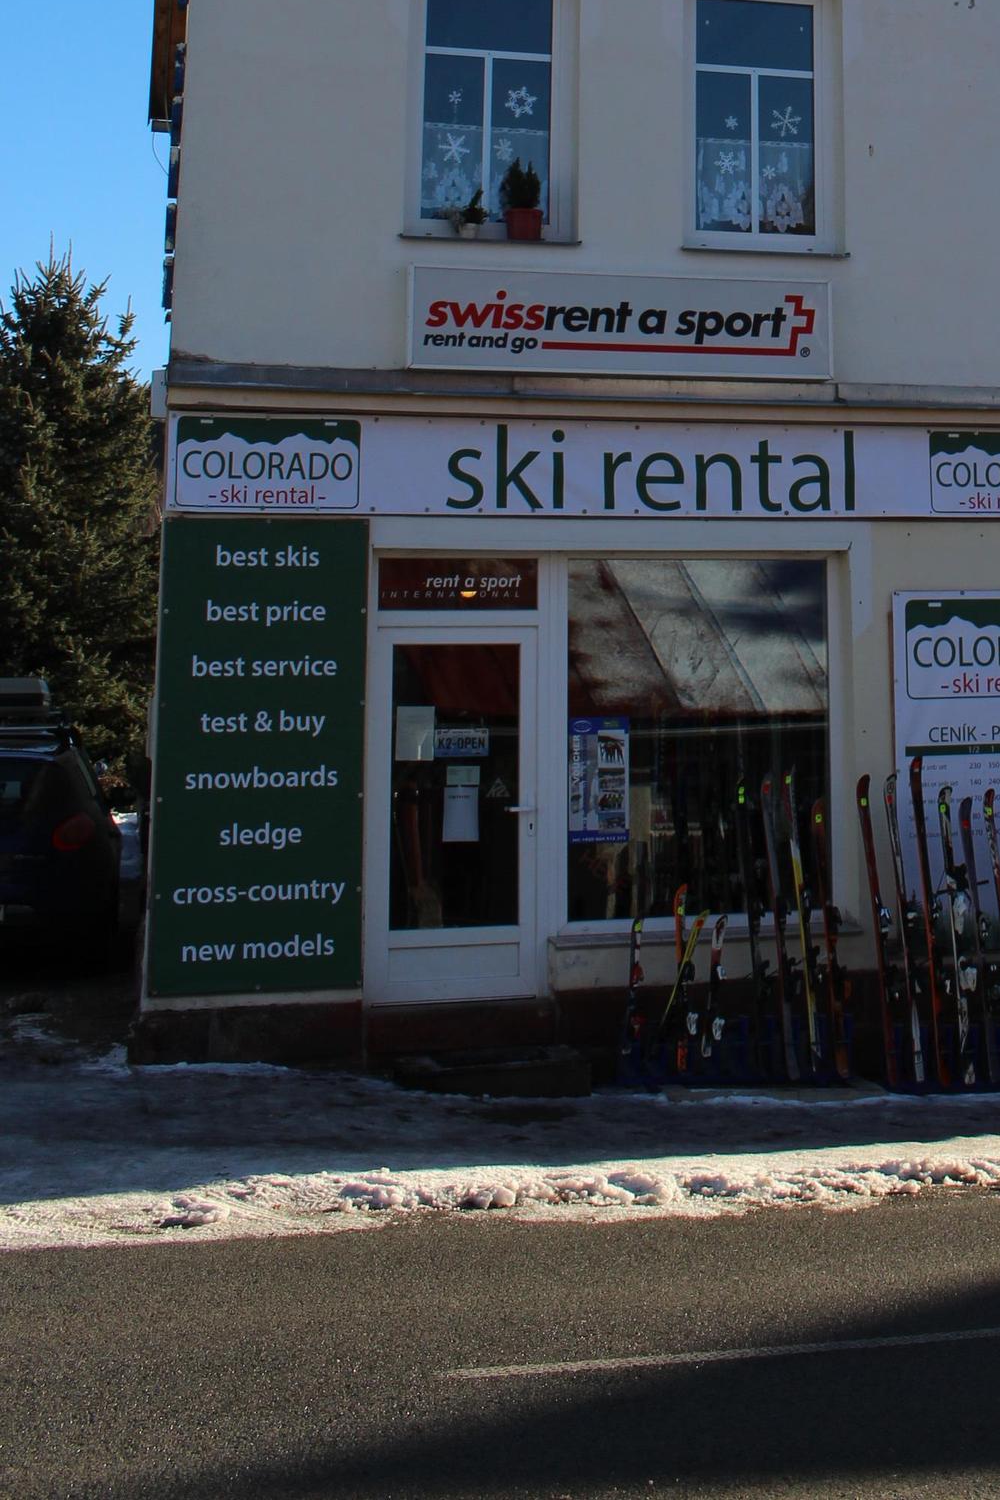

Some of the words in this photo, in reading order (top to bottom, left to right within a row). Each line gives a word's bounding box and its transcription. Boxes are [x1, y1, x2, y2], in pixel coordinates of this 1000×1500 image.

[638, 309, 669, 334] a
[676, 306, 787, 345] sport
[423, 332, 466, 348] rent
[467, 333, 508, 348] and
[511, 337, 538, 354] go
[182, 450, 353, 481] COLORADO
[446, 423, 566, 510] ski
[602, 430, 857, 512] rental
[216, 544, 268, 567] best
[275, 545, 320, 567] skis
[381, 590, 521, 599] INTERNAONAL
[425, 574, 460, 588] rent
[464, 577, 475, 588] a
[480, 573, 522, 592] sport
[206, 599, 259, 621] best
[266, 600, 326, 627] price
[192, 655, 245, 677] best
[252, 655, 338, 677] service
[200, 712, 248, 733] test
[254, 710, 273, 732] &
[279, 709, 326, 737] buy
[928, 723, 977, 743] CENÍK
[437, 737, 485, 750] K2-OPEN
[572, 733, 581, 785] VOUCHER
[185, 764, 338, 790] snowboards
[219, 821, 303, 850] sledge
[173, 879, 346, 905] cross-country
[181, 941, 236, 963] new
[242, 933, 335, 960] models
